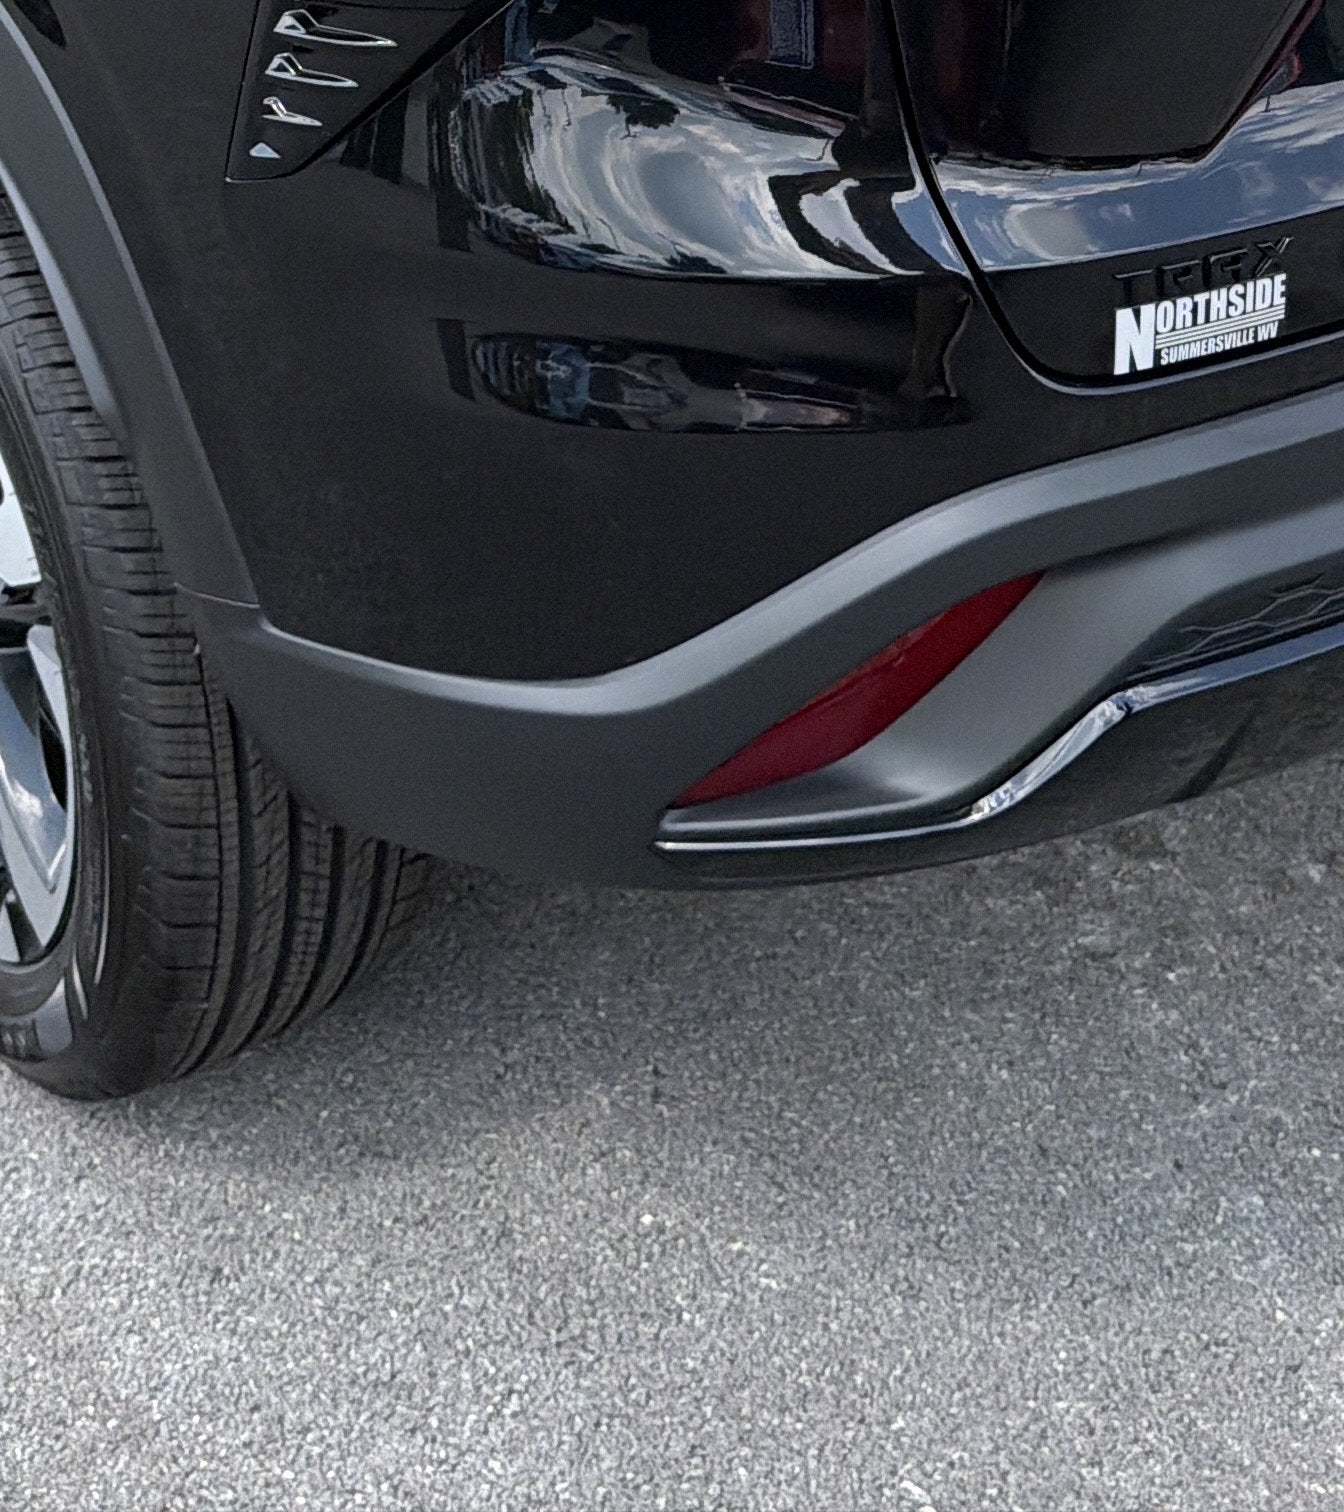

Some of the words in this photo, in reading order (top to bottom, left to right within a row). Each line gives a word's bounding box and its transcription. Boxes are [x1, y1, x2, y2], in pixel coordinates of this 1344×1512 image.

[1113, 273, 1288, 376] NORTHSIDE
[1159, 326, 1256, 366] SUMMERSVILLE
[1257, 320, 1279, 343] WV
